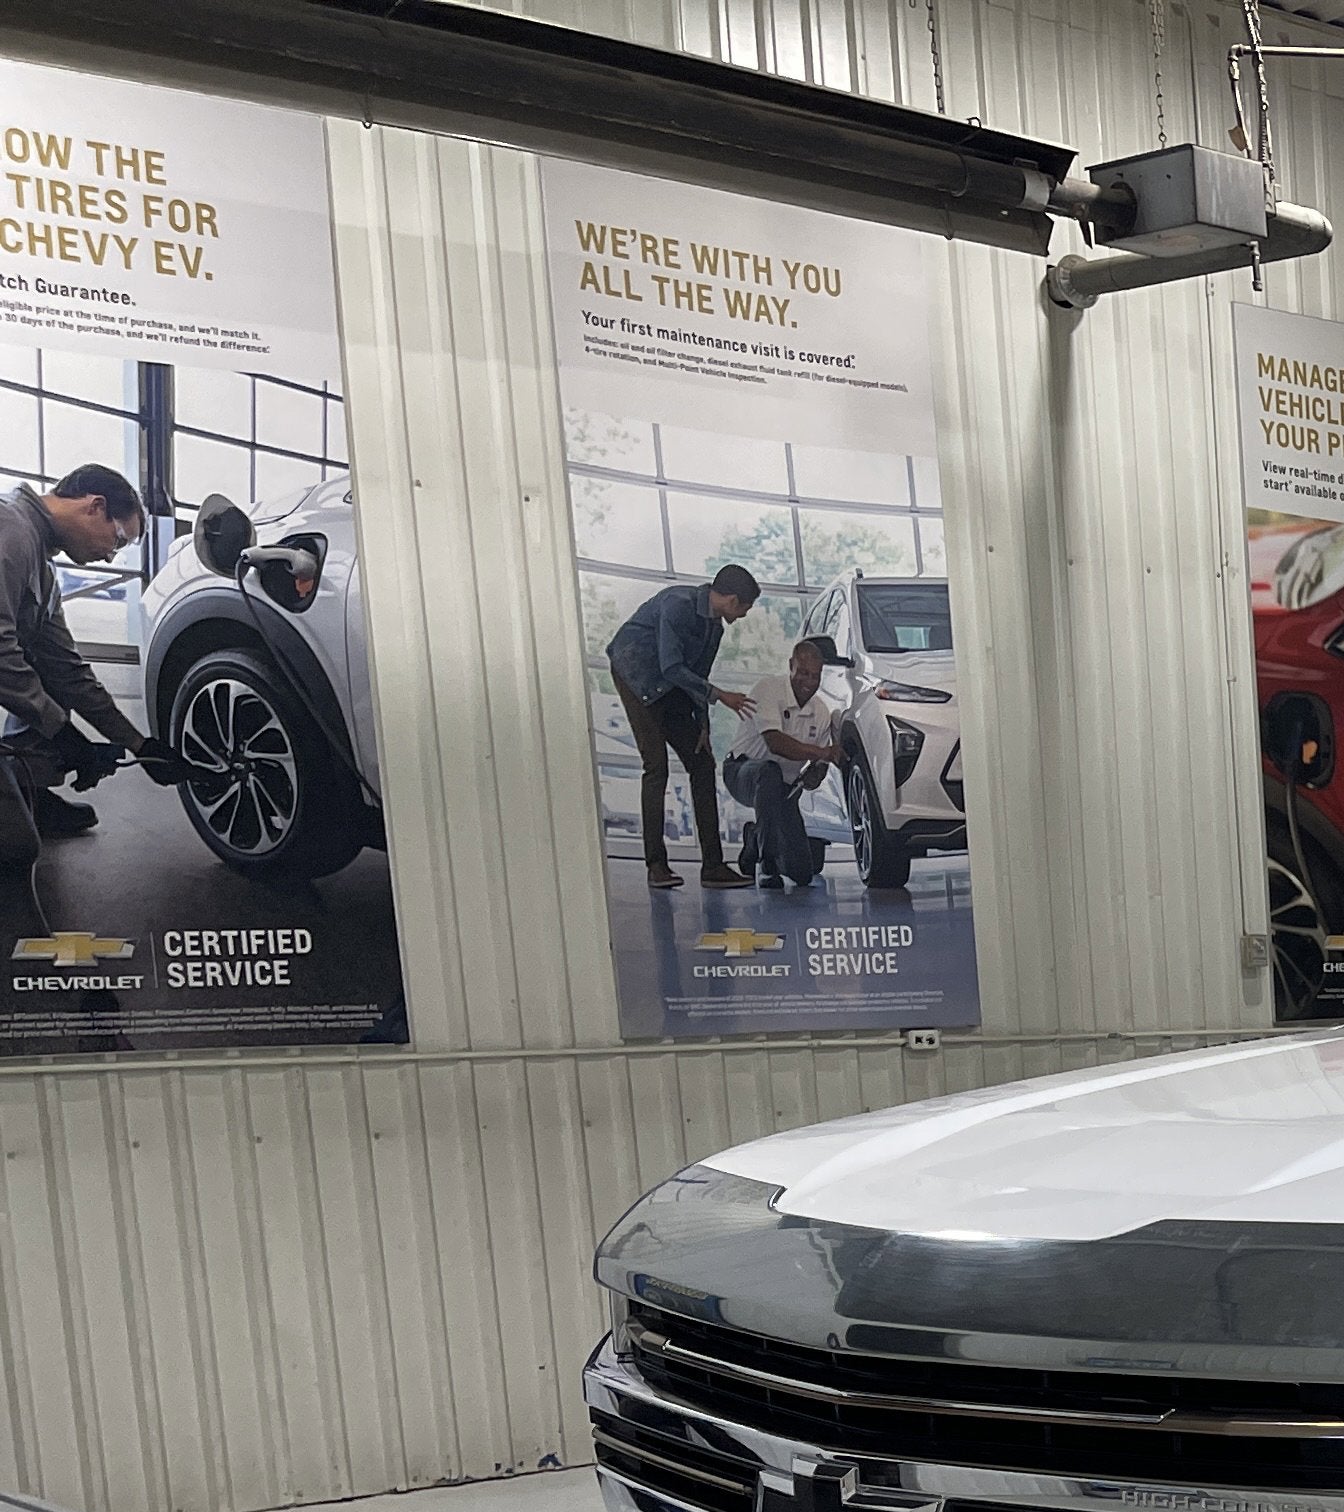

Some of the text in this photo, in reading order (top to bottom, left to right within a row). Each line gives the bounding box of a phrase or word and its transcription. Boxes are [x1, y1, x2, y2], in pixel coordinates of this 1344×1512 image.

[5, 127, 167, 186] OW THE
[5, 172, 220, 239] TIRES FOR
[0, 217, 214, 282] CHEVY EV.
[574, 219, 842, 298] WE'RE WITH YOU
[35, 278, 136, 307] Guarantee.
[579, 261, 799, 329] ALL THE WAY.
[5, 312, 17, 323] 30
[20, 316, 43, 328] days
[58, 321, 74, 331] the
[77, 324, 124, 338] purchase,
[126, 330, 143, 340] and
[146, 332, 167, 341] we'll
[169, 335, 201, 346] refund
[203, 339, 218, 348] the
[36, 305, 60, 316] price
[63, 309, 73, 317] at
[76, 310, 91, 320] the
[94, 312, 116, 324] time
[118, 316, 128, 325] of
[130, 318, 177, 332] purchase,
[179, 324, 195, 334] and
[198, 326, 219, 336] we'll
[221, 329, 249, 340] match
[581, 309, 616, 330] Your
[620, 317, 653, 338] first
[656, 328, 748, 354] maintenance
[750, 341, 780, 359] visit
[783, 345, 796, 361] is
[1259, 418, 1321, 454] YOUR
[1261, 460, 1287, 476] View
[1289, 466, 1336, 485] real-time
[1294, 482, 1337, 501] available
[163, 928, 313, 958] CERTIFIED
[805, 925, 914, 951] CERTIFIED
[166, 959, 292, 988] SERVICE
[693, 964, 791, 978] CHEVROLET
[808, 951, 898, 977] SERVICE
[12, 975, 145, 991] CHEVROLET
[1121, 1489, 1191, 1511] HIGH
